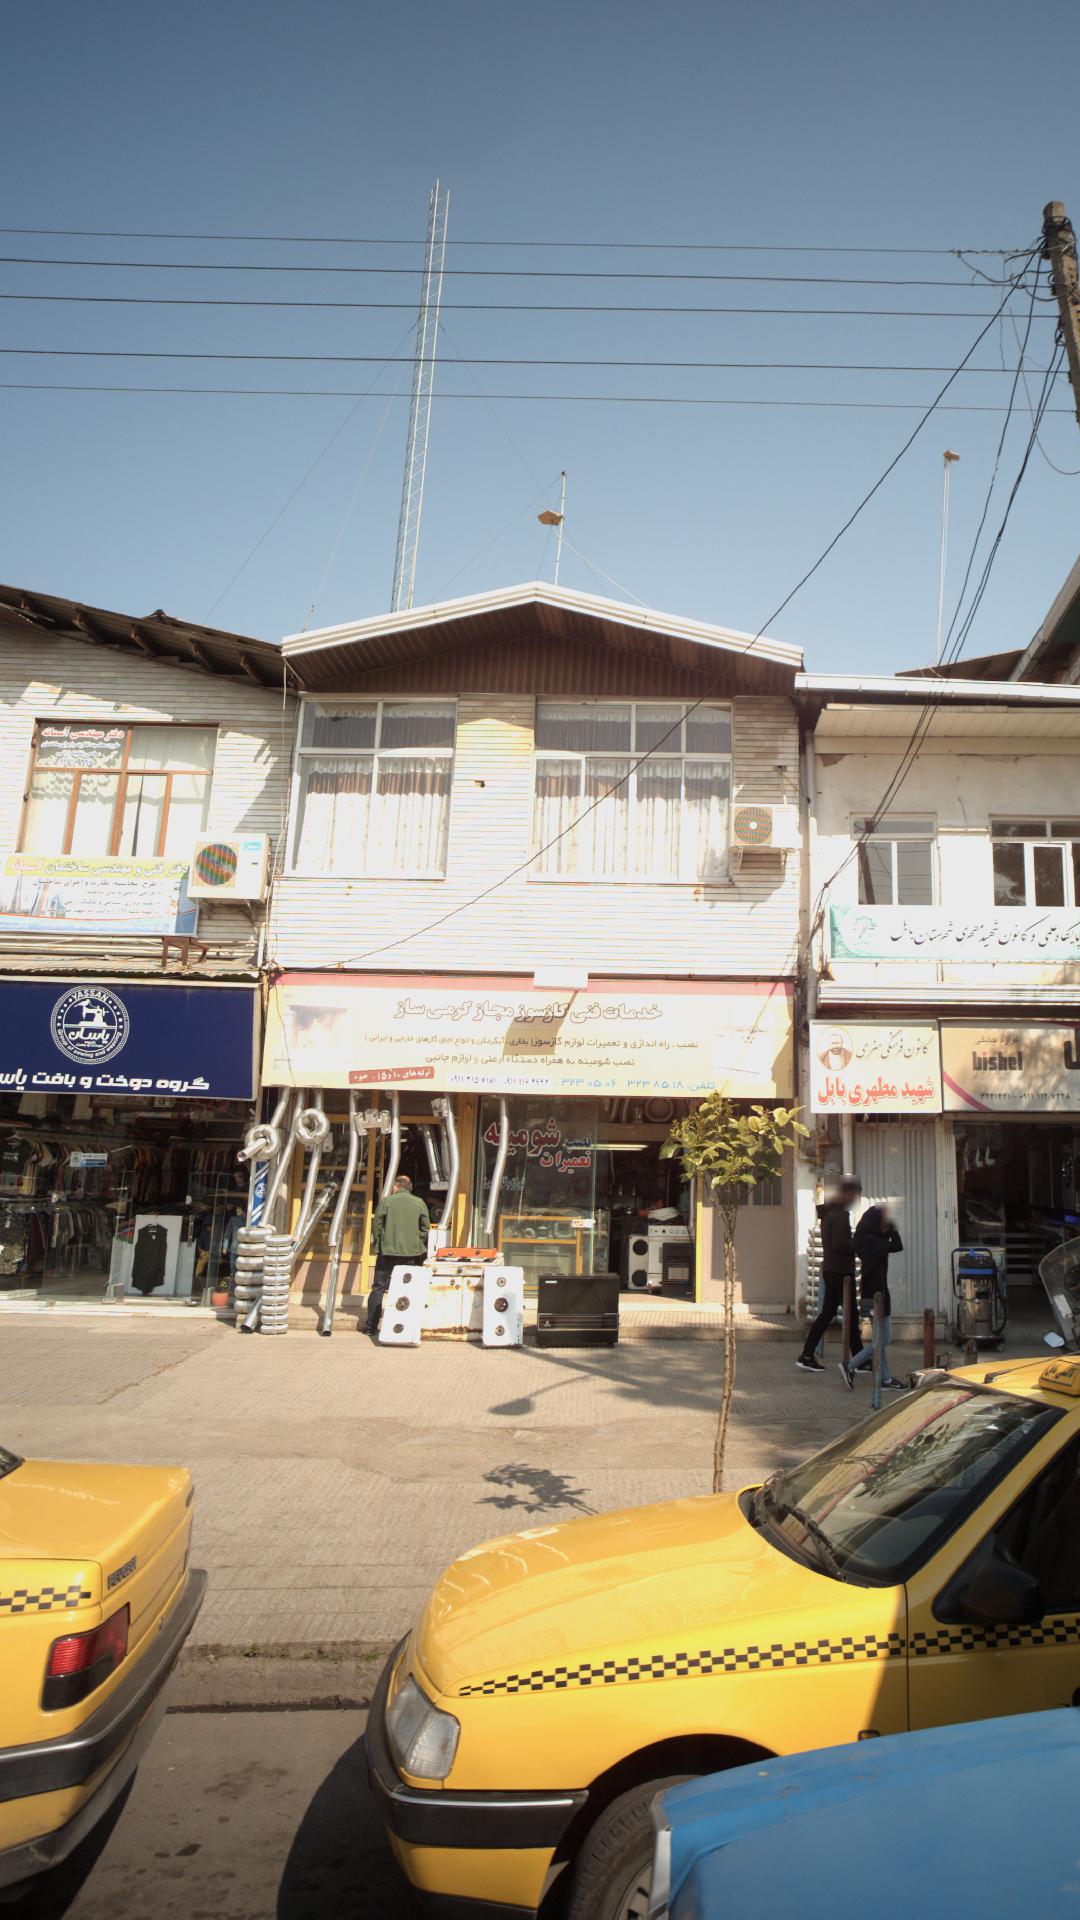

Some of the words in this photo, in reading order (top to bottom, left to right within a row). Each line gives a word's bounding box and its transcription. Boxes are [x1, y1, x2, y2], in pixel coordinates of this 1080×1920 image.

[71, 989, 109, 1002] YASSAN
[394, 997, 426, 1019] ساز
[473, 1000, 515, 1022] مجاز
[515, 1002, 570, 1023] گازسوز
[570, 1002, 602, 1024] فنی
[603, 1002, 663, 1021] خدمات
[564, 1038, 585, 1047] لوازم
[587, 1039, 620, 1049] تعمیرات
[630, 1040, 657, 1049] اندازی
[425, 1053, 449, 1064] جانبی
[451, 1053, 472, 1064] لوازم
[541, 1056, 563, 1066] همراه
[566, 1058, 576, 1066] به
[578, 1057, 611, 1067] شومینه
[612, 1058, 635, 1068] نصب
[972, 1051, 1023, 1071] bishel
[32, 1072, 76, 1087] بافت
[80, 1076, 93, 1088] و
[96, 1075, 152, 1090] دوخت
[156, 1076, 210, 1092] گروه
[817, 1076, 847, 1106] بابل
[848, 1076, 898, 1106] مطهری
[900, 1077, 935, 1105] شهید
[484, 1117, 561, 1157] شومیه
[540, 1151, 592, 1174] تعمیرات
